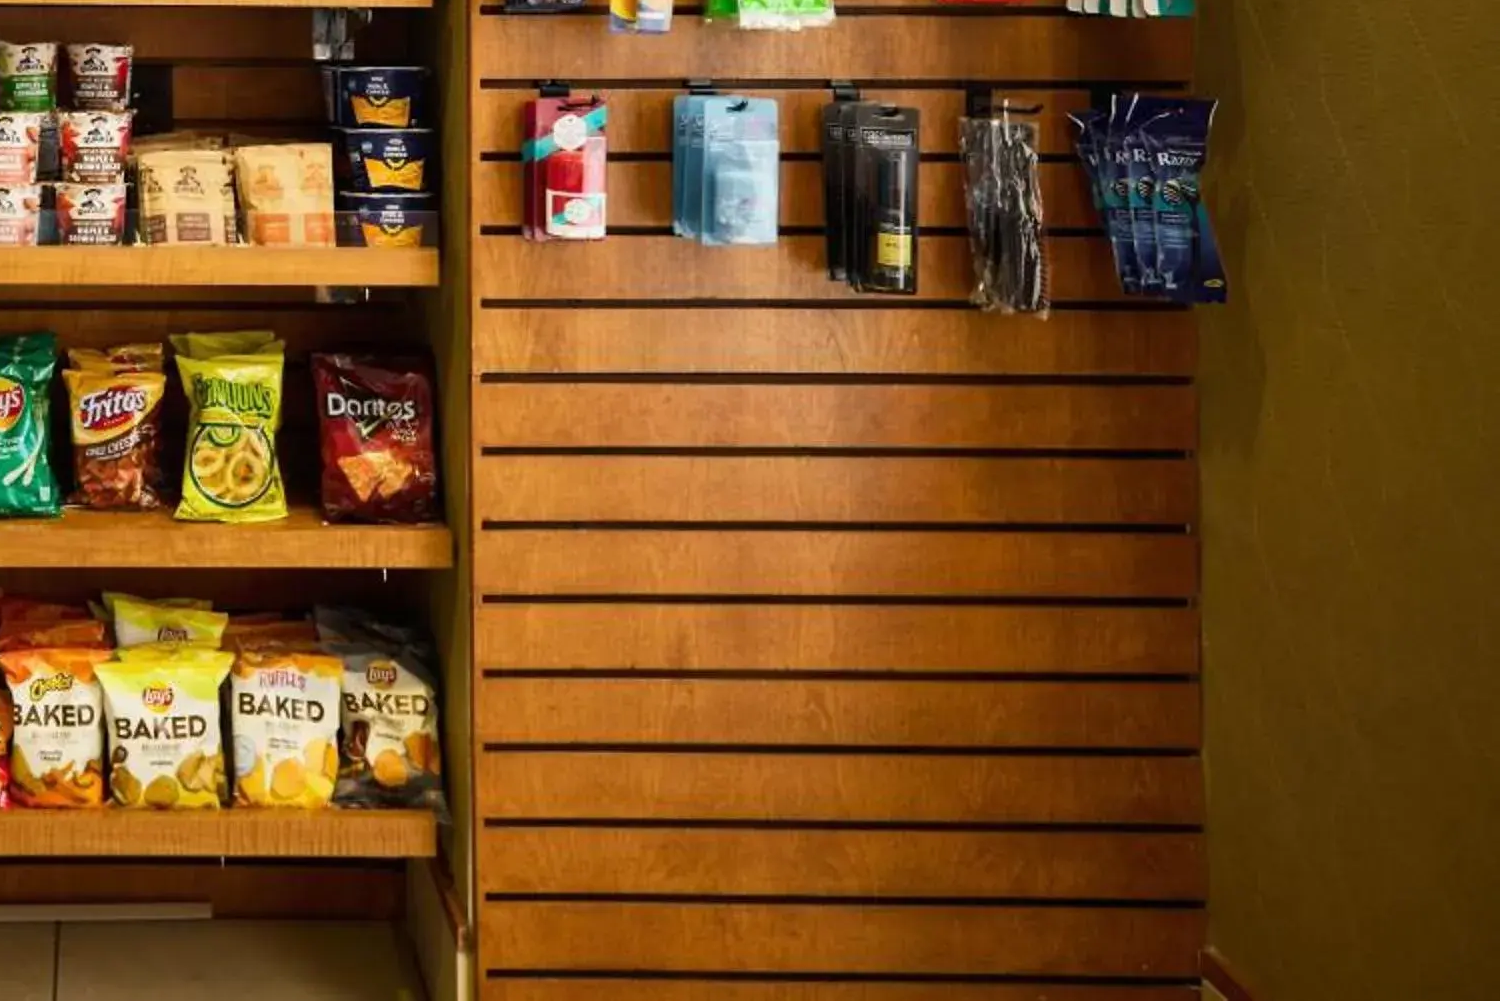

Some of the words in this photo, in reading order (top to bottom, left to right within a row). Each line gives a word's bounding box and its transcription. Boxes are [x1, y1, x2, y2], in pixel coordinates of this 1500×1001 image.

[80, 389, 145, 427] Fritos
[327, 393, 415, 419] Doritos
[13, 704, 95, 727] BAKED
[239, 693, 324, 722] BAKED
[344, 693, 429, 716] BAKED
[114, 716, 207, 739] BAKED
